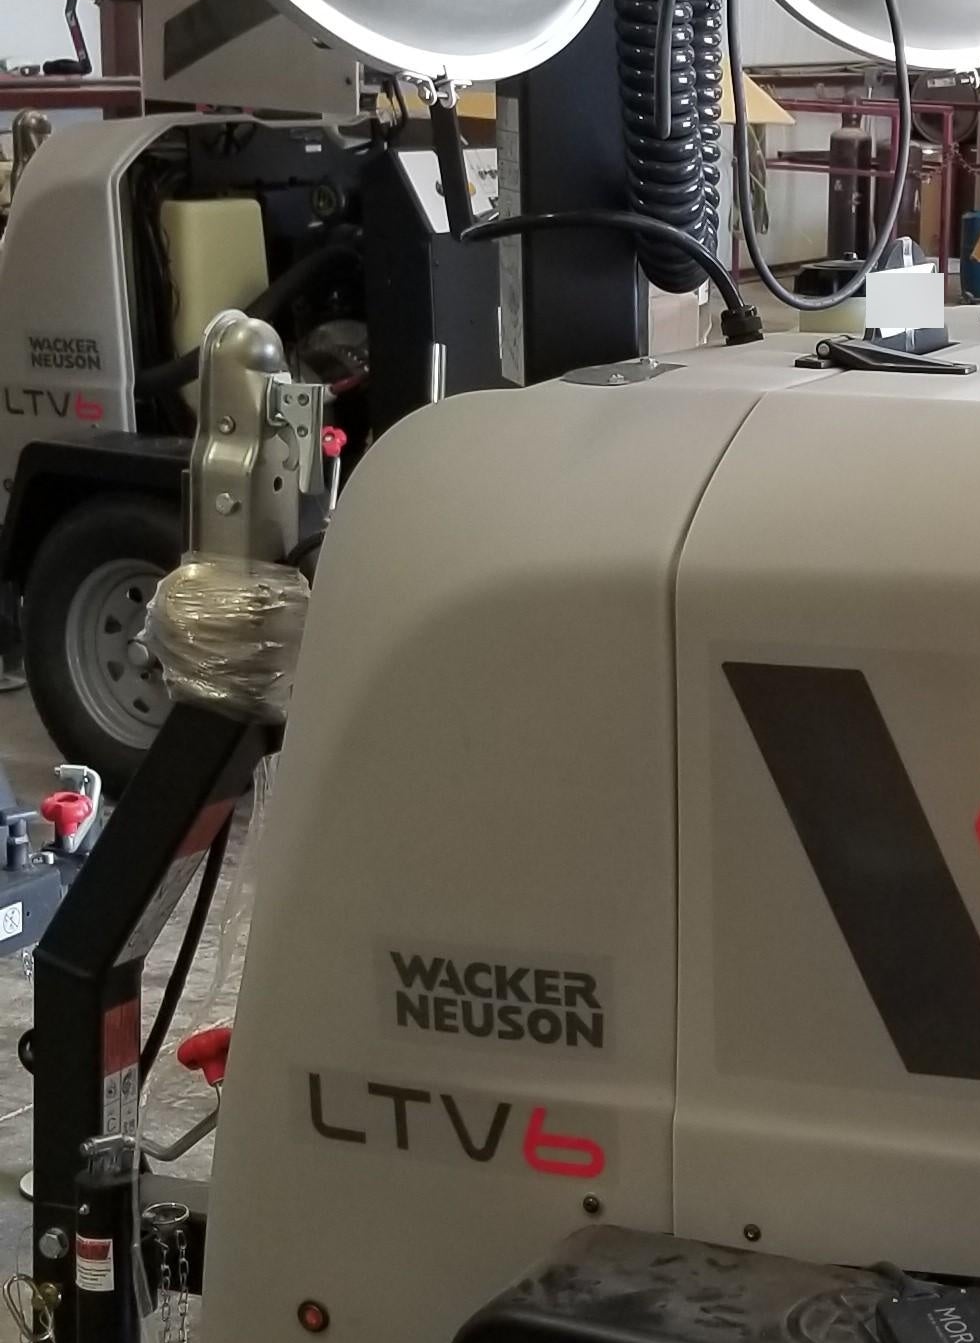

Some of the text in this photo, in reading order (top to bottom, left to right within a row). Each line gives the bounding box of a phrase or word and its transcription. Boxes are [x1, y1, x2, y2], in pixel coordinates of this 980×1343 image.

[29, 336, 99, 354] WACKER
[31, 353, 101, 371] NEUSON
[4, 387, 105, 423] LTV6
[389, 951, 603, 1009] WACKER
[396, 990, 604, 1049] NEUSON
[309, 1072, 605, 1179] LTV6
